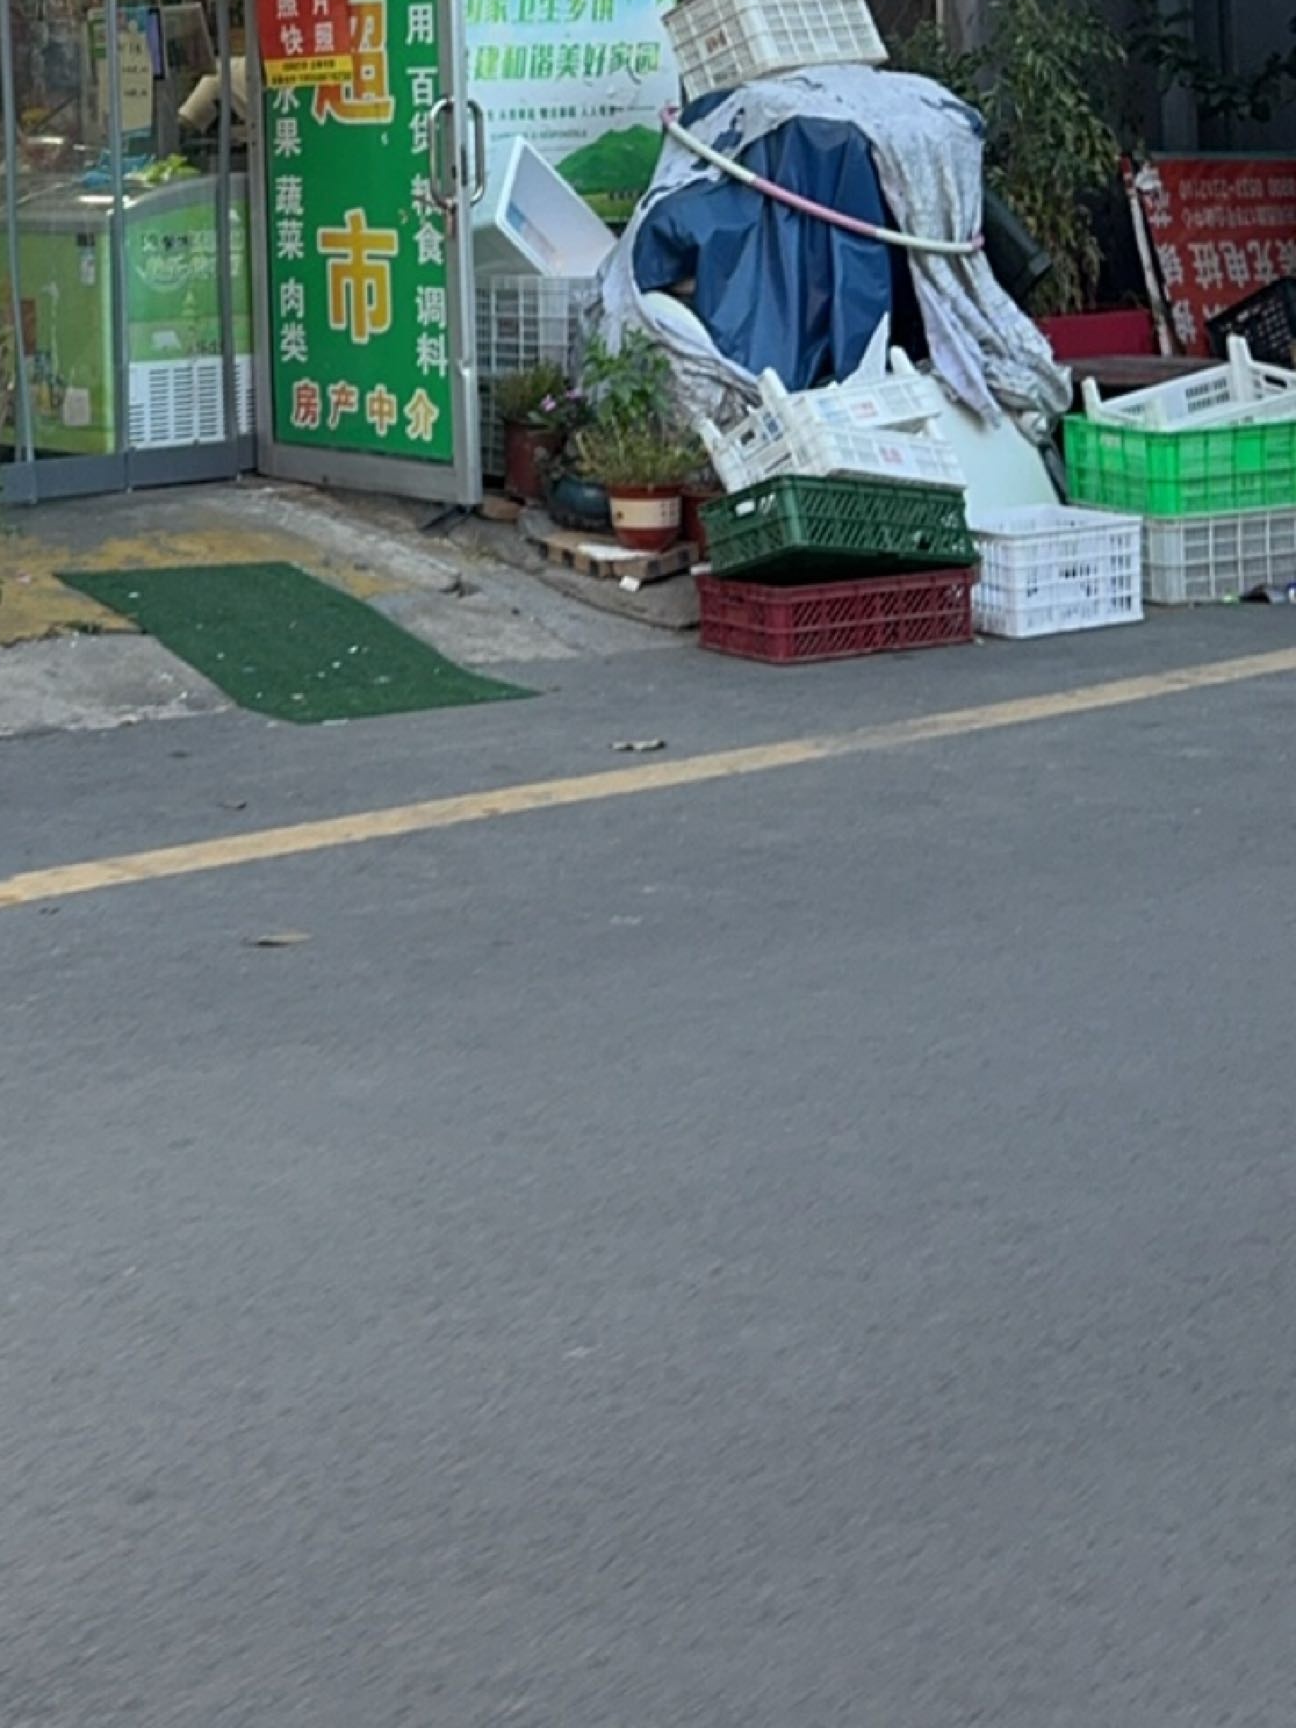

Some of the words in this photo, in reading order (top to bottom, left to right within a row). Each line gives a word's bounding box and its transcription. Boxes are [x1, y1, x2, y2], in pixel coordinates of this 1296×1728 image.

[274, 174, 305, 260] 蔬菜
[279, 277, 309, 364] 肉类
[415, 285, 448, 378] 调料
[291, 378, 440, 443] 房产中介
